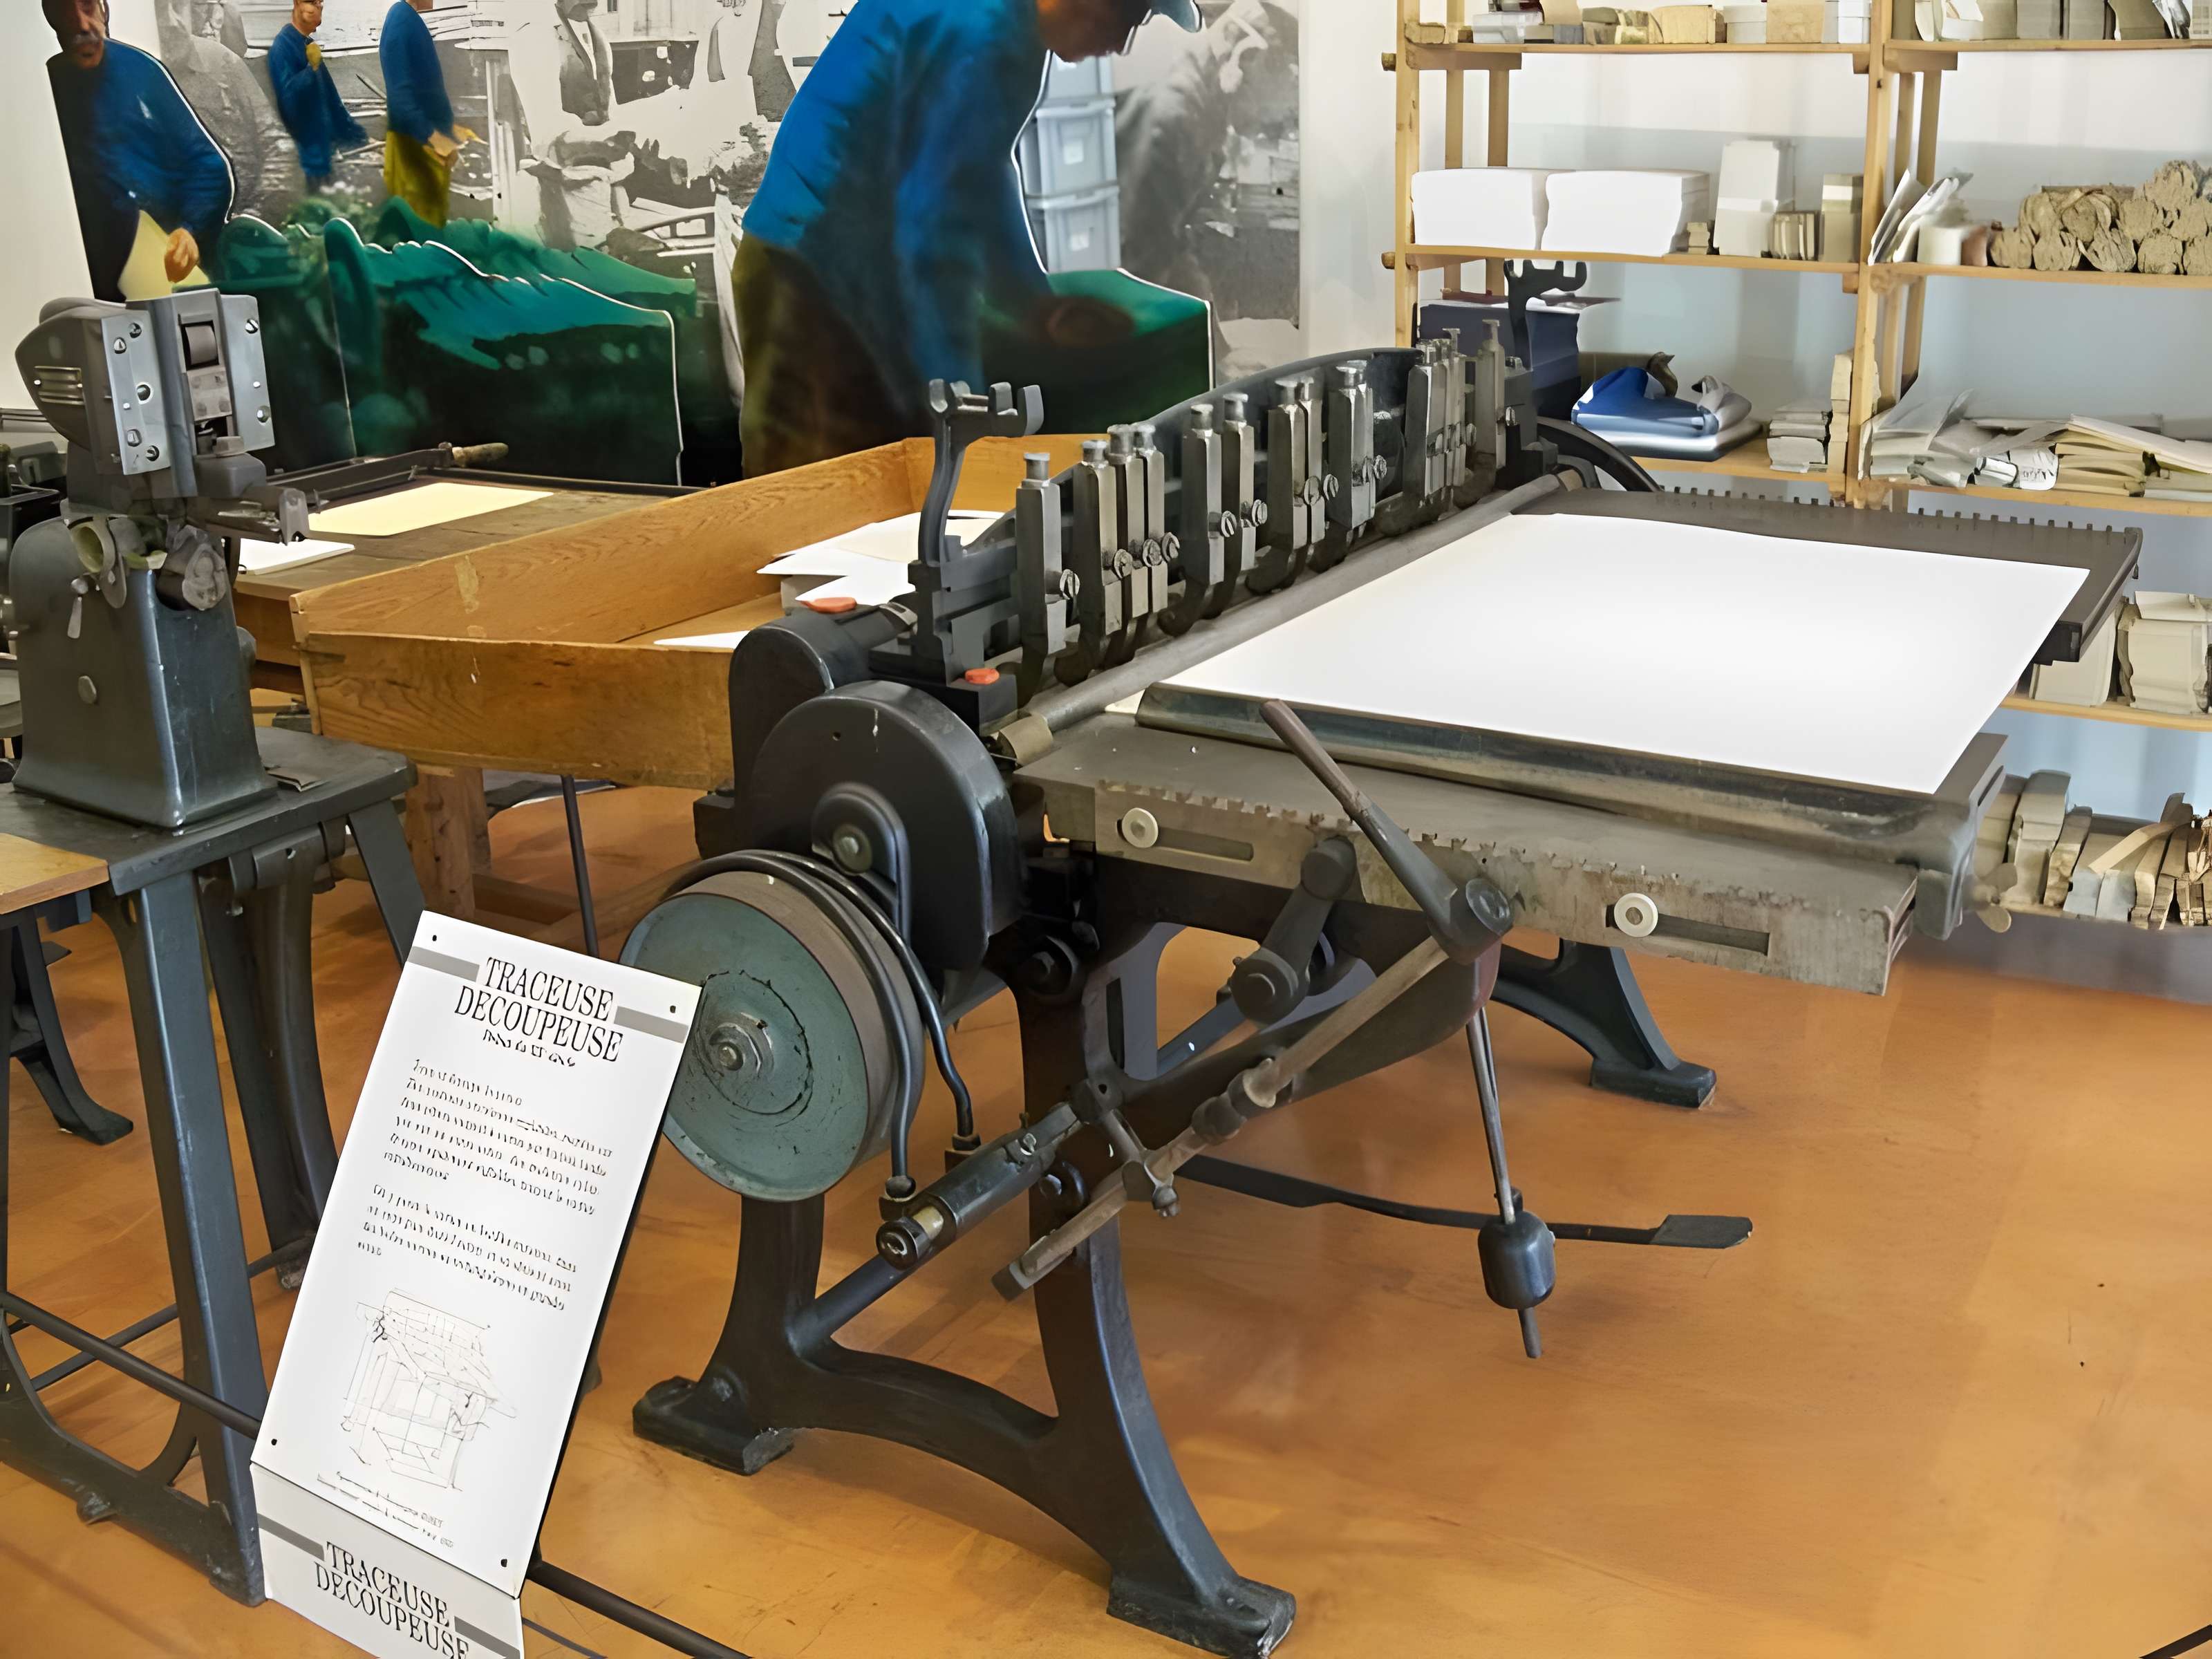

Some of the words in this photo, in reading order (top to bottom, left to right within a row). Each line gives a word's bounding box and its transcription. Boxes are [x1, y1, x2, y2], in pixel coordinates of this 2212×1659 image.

[454, 985, 624, 1062] DECOUPEUSE
[485, 957, 614, 1021] TRACEUSE
[326, 1541, 450, 1627] TRACEUSE
